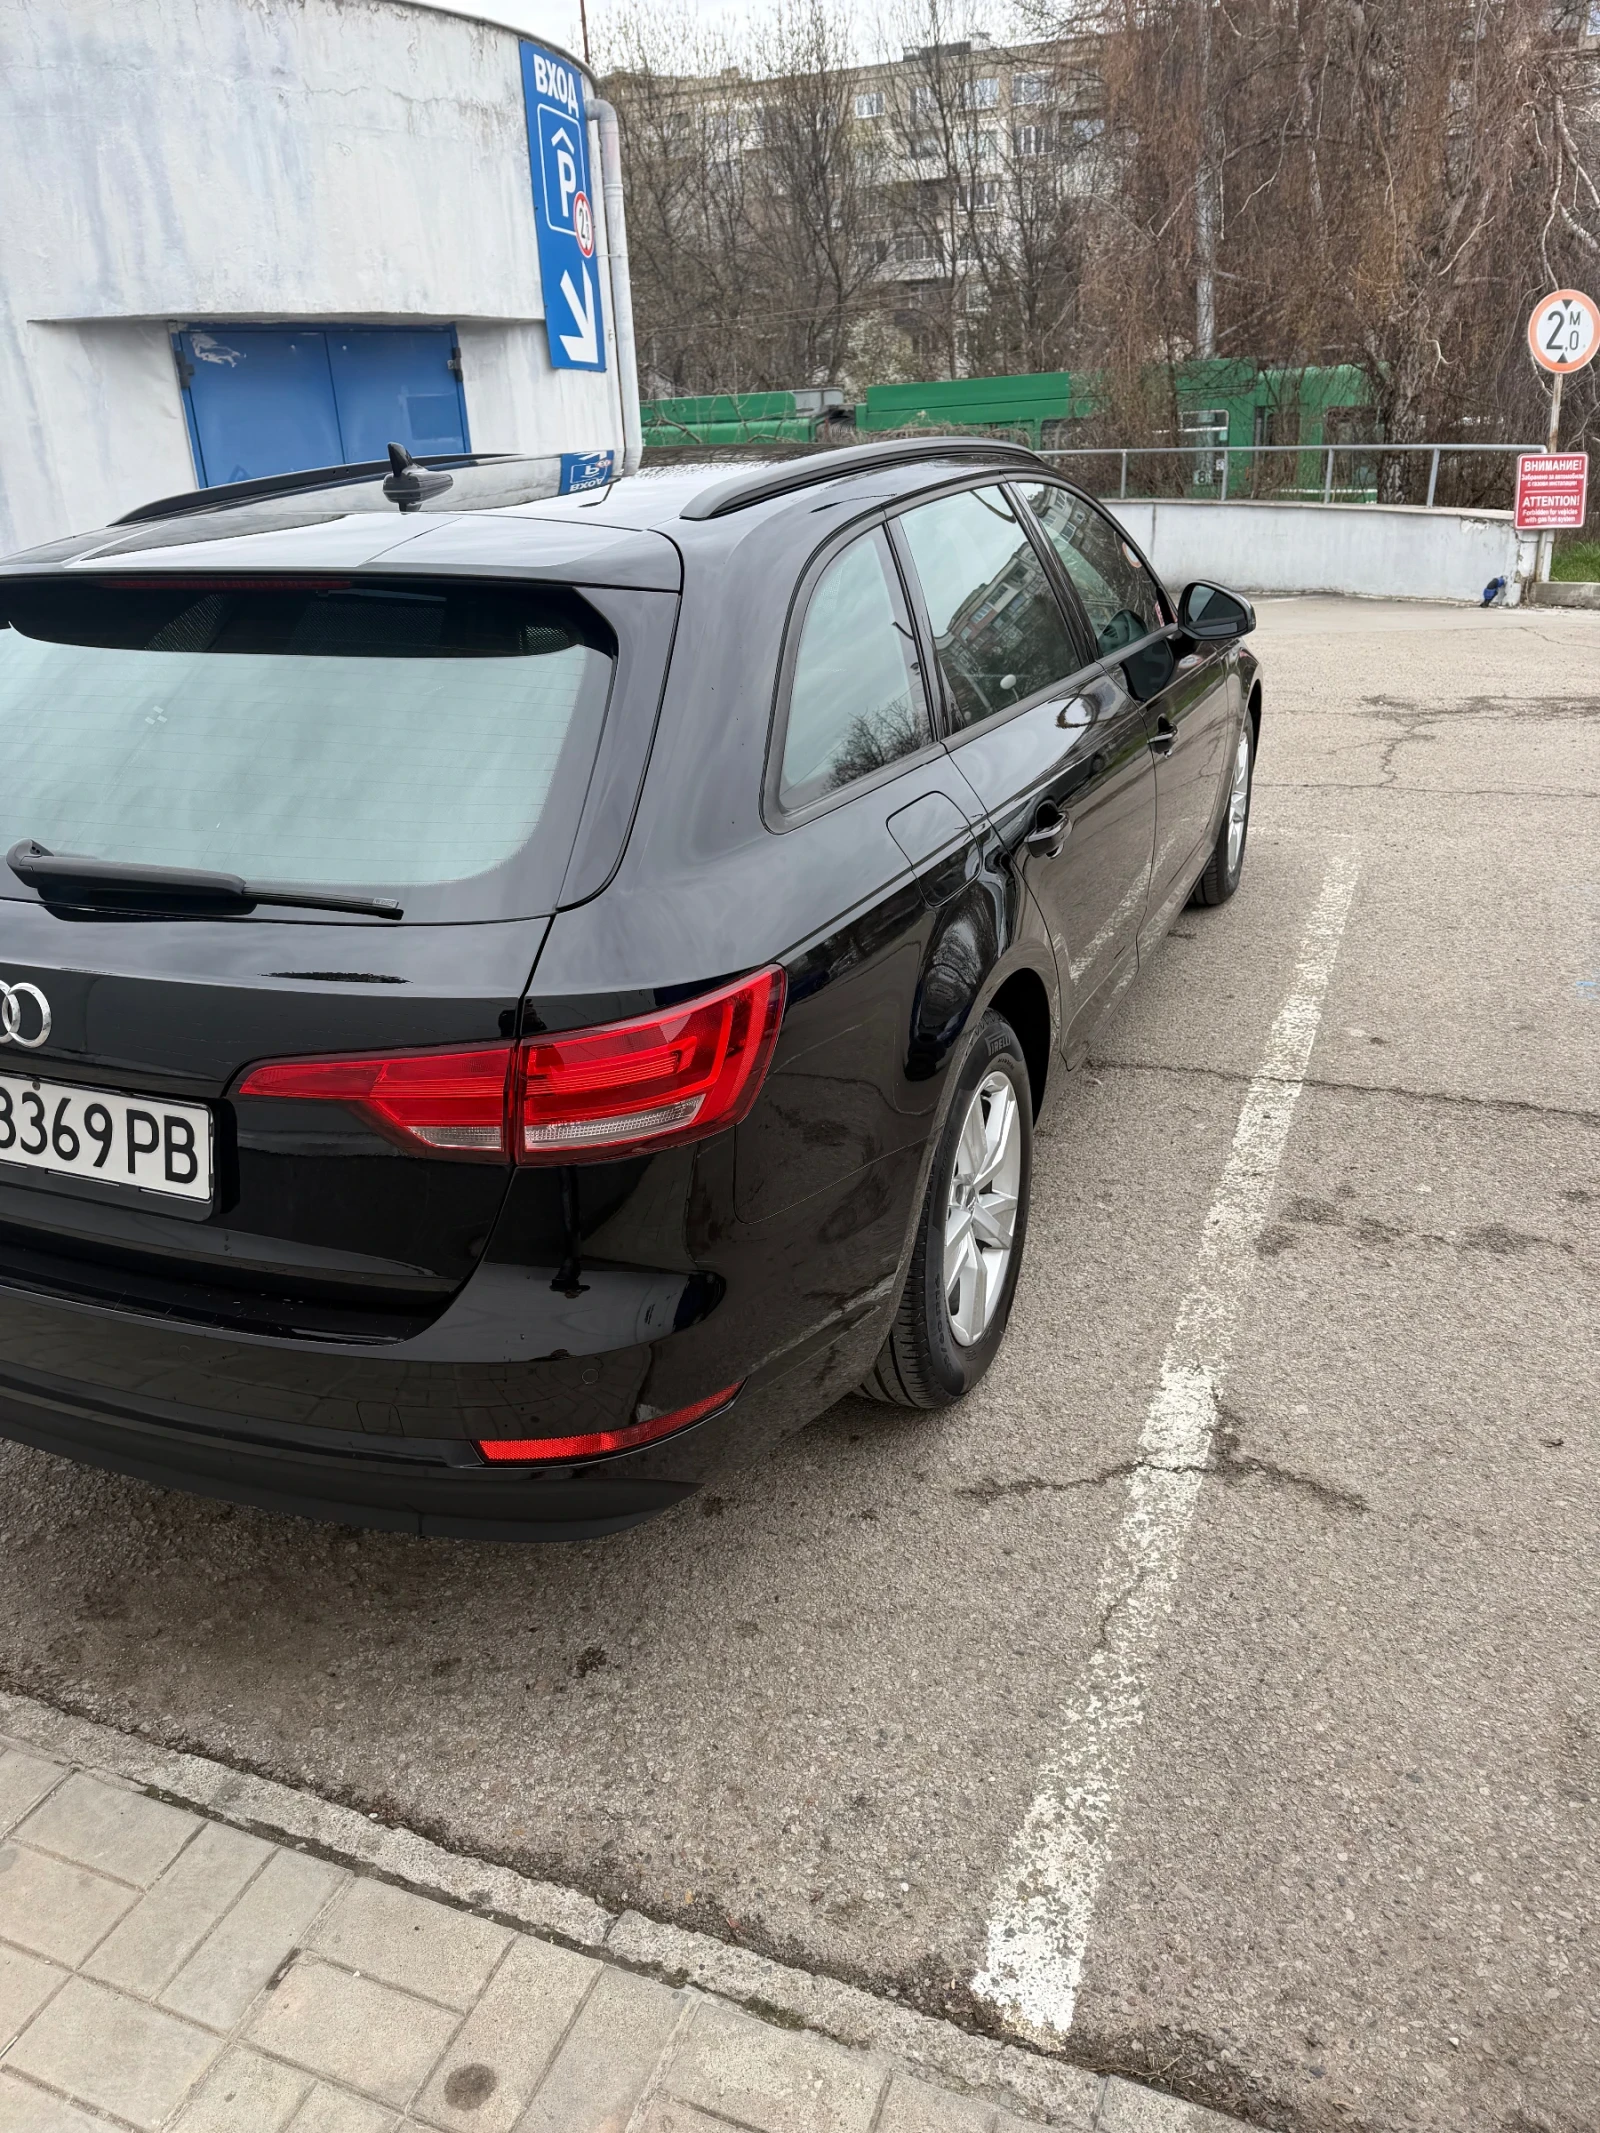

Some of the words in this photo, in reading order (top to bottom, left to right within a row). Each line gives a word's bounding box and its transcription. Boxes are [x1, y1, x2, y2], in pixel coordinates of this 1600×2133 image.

[533, 54, 580, 118] ВХОД
[557, 149, 577, 218] P
[1524, 460, 1582, 472] ВНИМАНИЕ!
[1522, 495, 1580, 507] ATTENTION!
